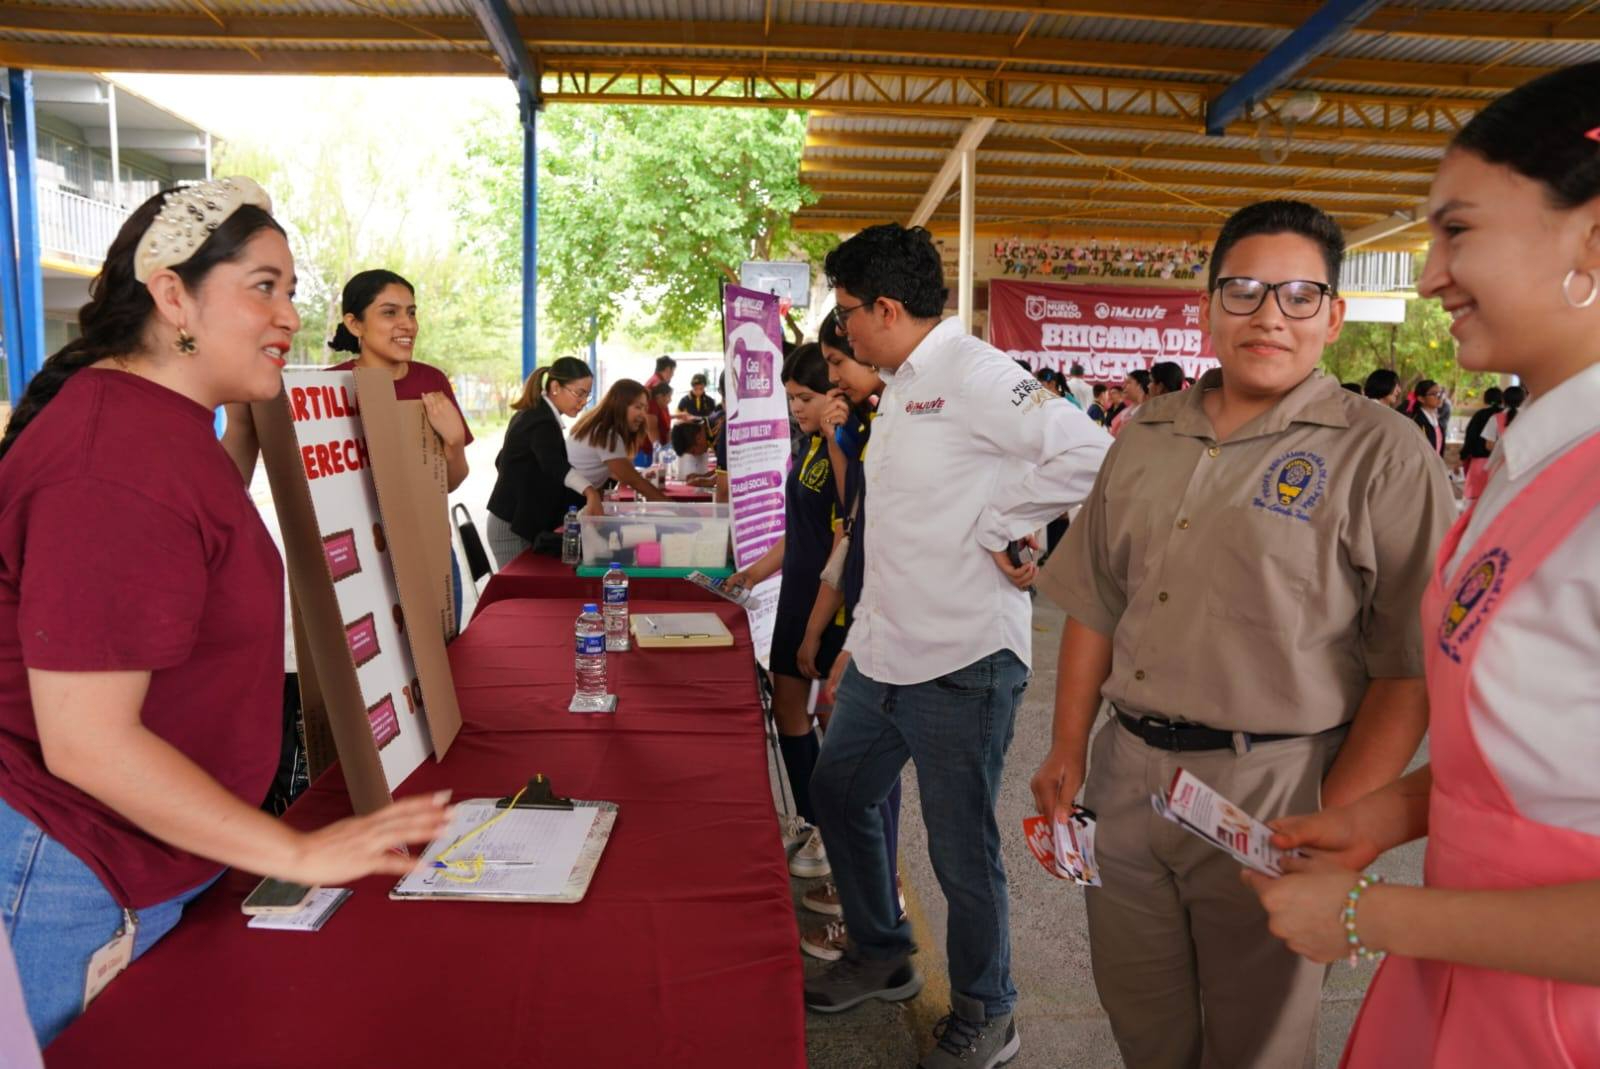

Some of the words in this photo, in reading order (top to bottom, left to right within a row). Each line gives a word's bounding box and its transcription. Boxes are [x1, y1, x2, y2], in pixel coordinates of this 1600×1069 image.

[1047, 303, 1079, 312] NUEVO
[1047, 310, 1082, 320] LAREDO
[1182, 303, 1199, 313] Jun
[1042, 323, 1161, 349] BRIGADA
[1165, 328, 1202, 352] DE
[291, 384, 361, 421] RTILL
[301, 437, 371, 481] ERECH
